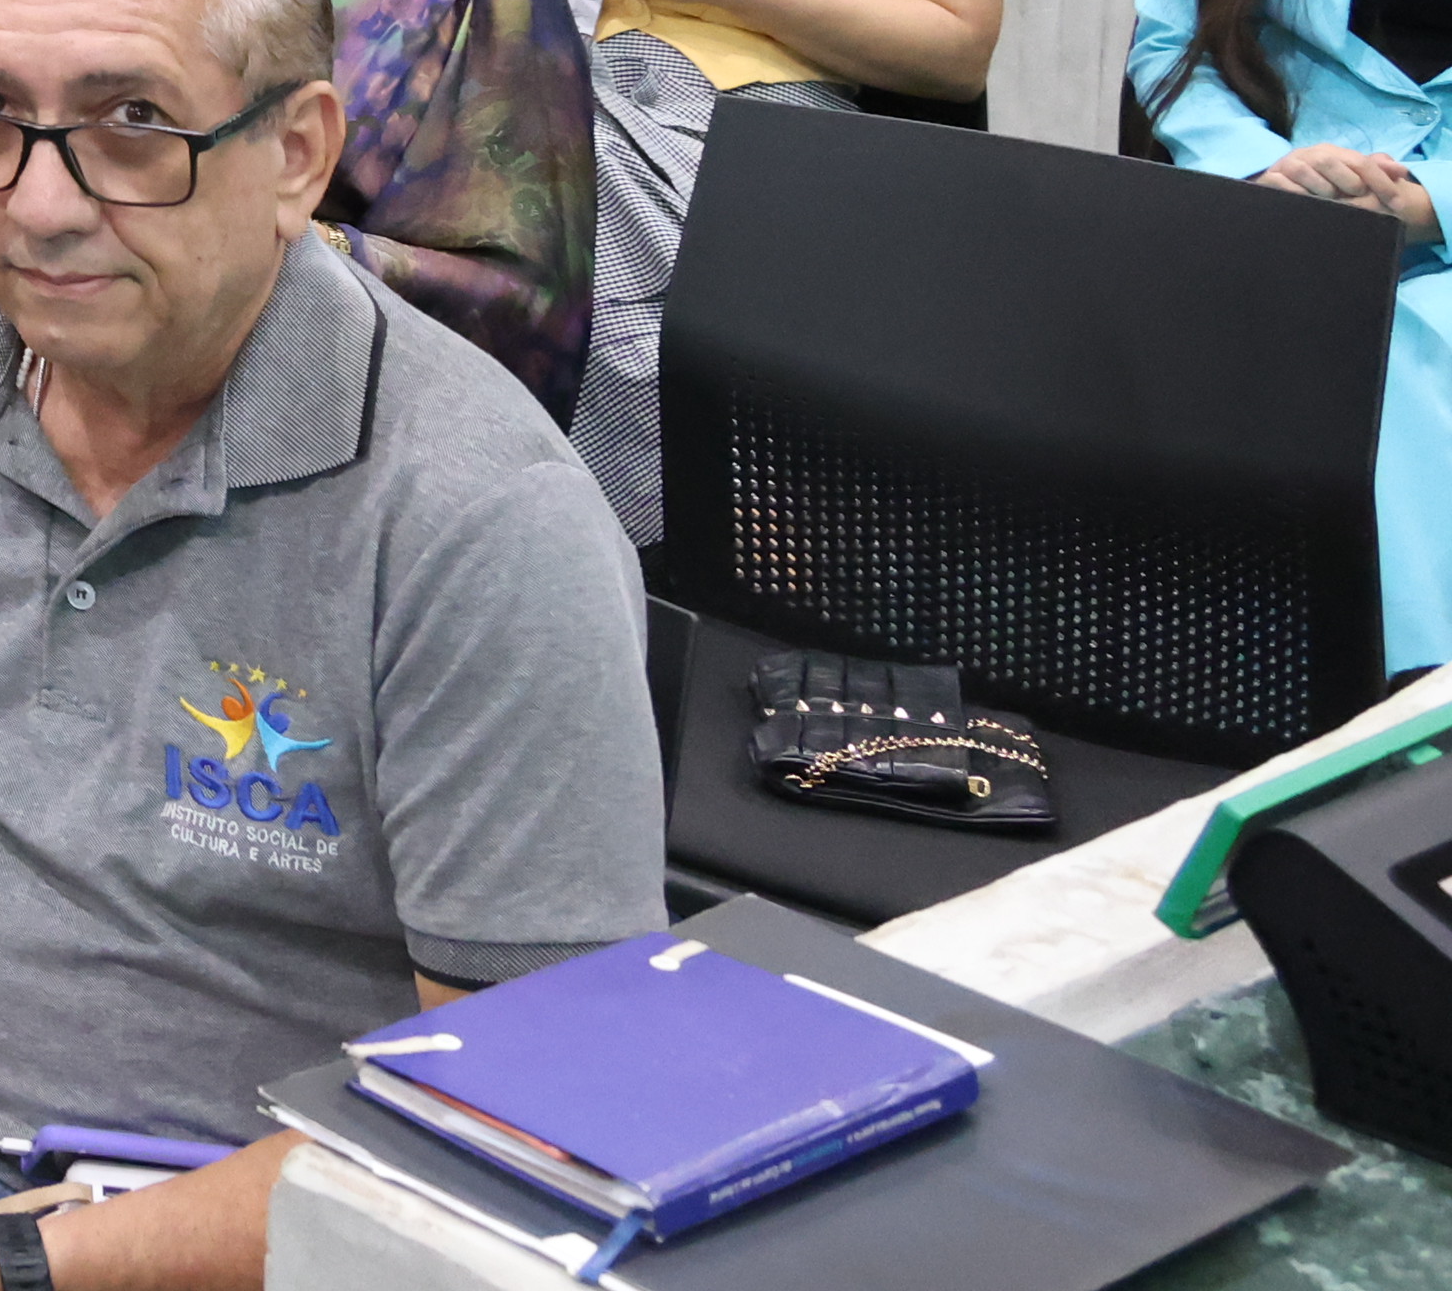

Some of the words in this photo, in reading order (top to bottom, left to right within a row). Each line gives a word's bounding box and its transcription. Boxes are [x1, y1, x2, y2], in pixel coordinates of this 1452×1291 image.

[163, 743, 341, 837] ISCA
[160, 801, 240, 836] INSTITUTO
[246, 825, 308, 853] SOCIAL
[316, 839, 340, 857] DE
[171, 823, 241, 860] CULTURA
[248, 847, 260, 863] E
[268, 851, 323, 873] ARTES
